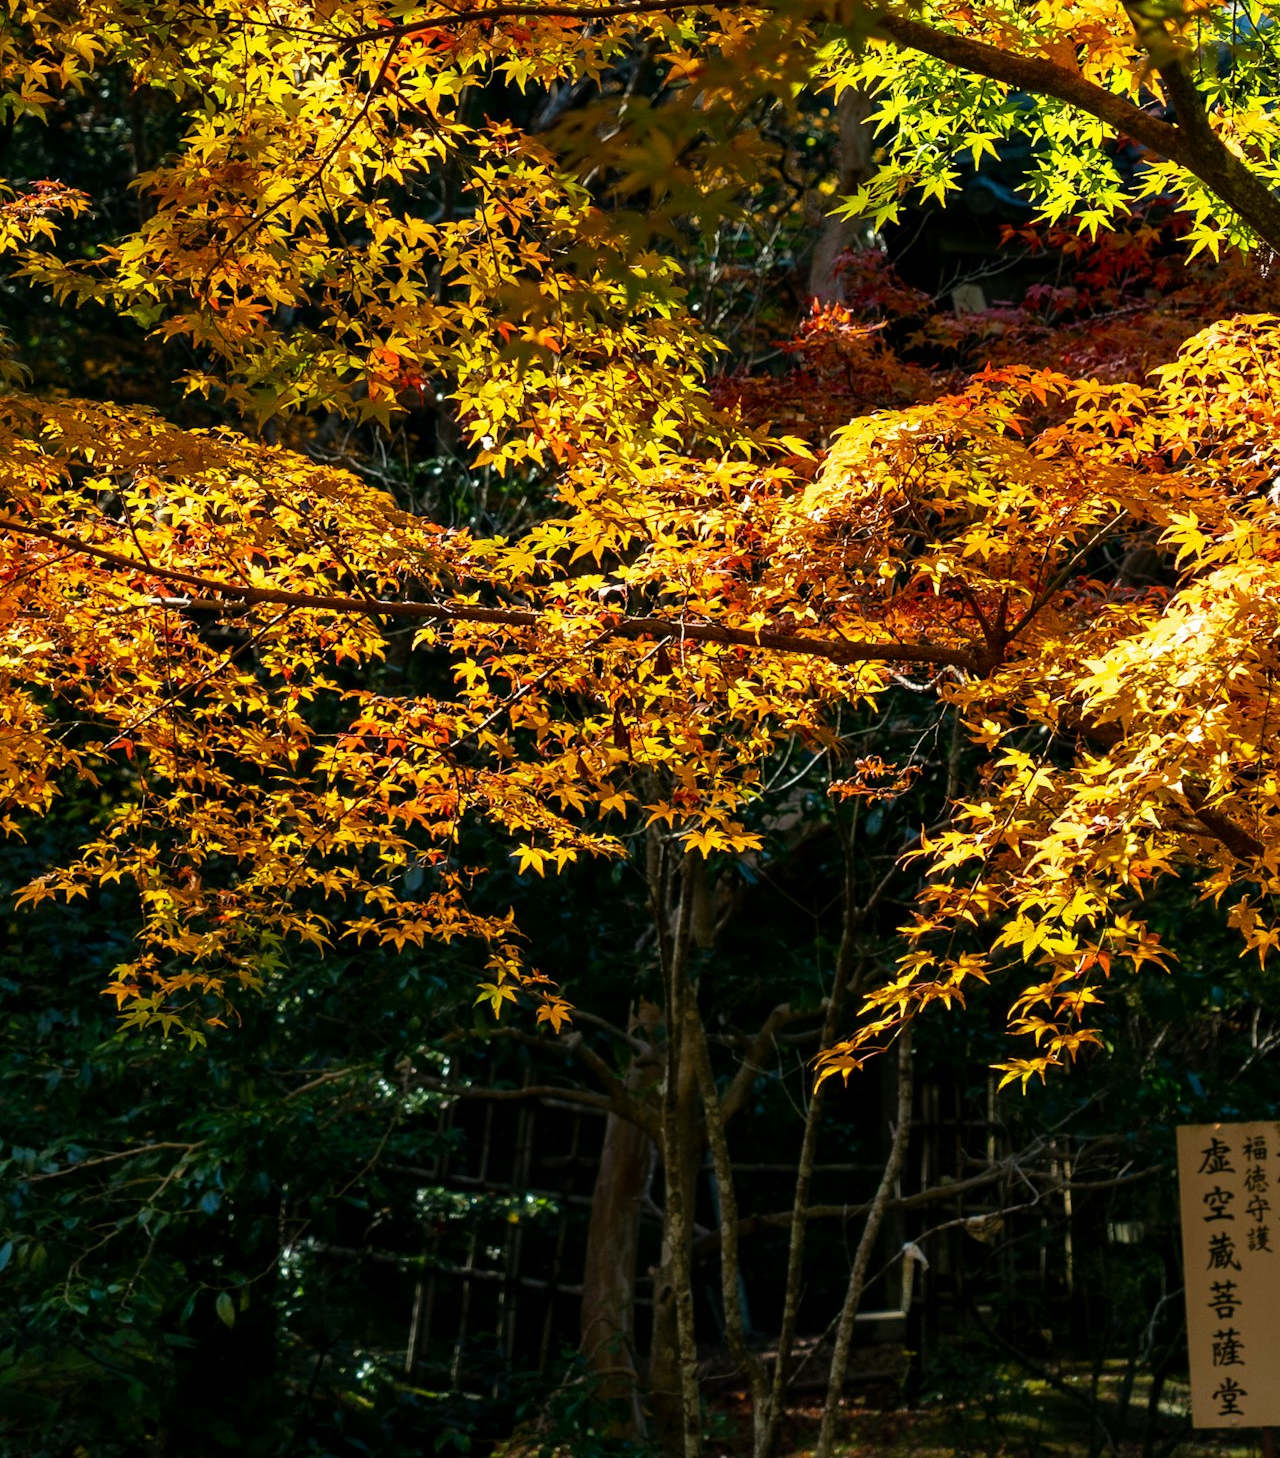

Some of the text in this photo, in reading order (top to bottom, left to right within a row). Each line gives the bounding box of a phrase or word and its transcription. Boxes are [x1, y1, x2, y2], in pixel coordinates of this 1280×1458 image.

[1197, 1138, 1247, 1416] 虚空蔵菩薩堂
[1242, 1136, 1273, 1253] 福徳守護
